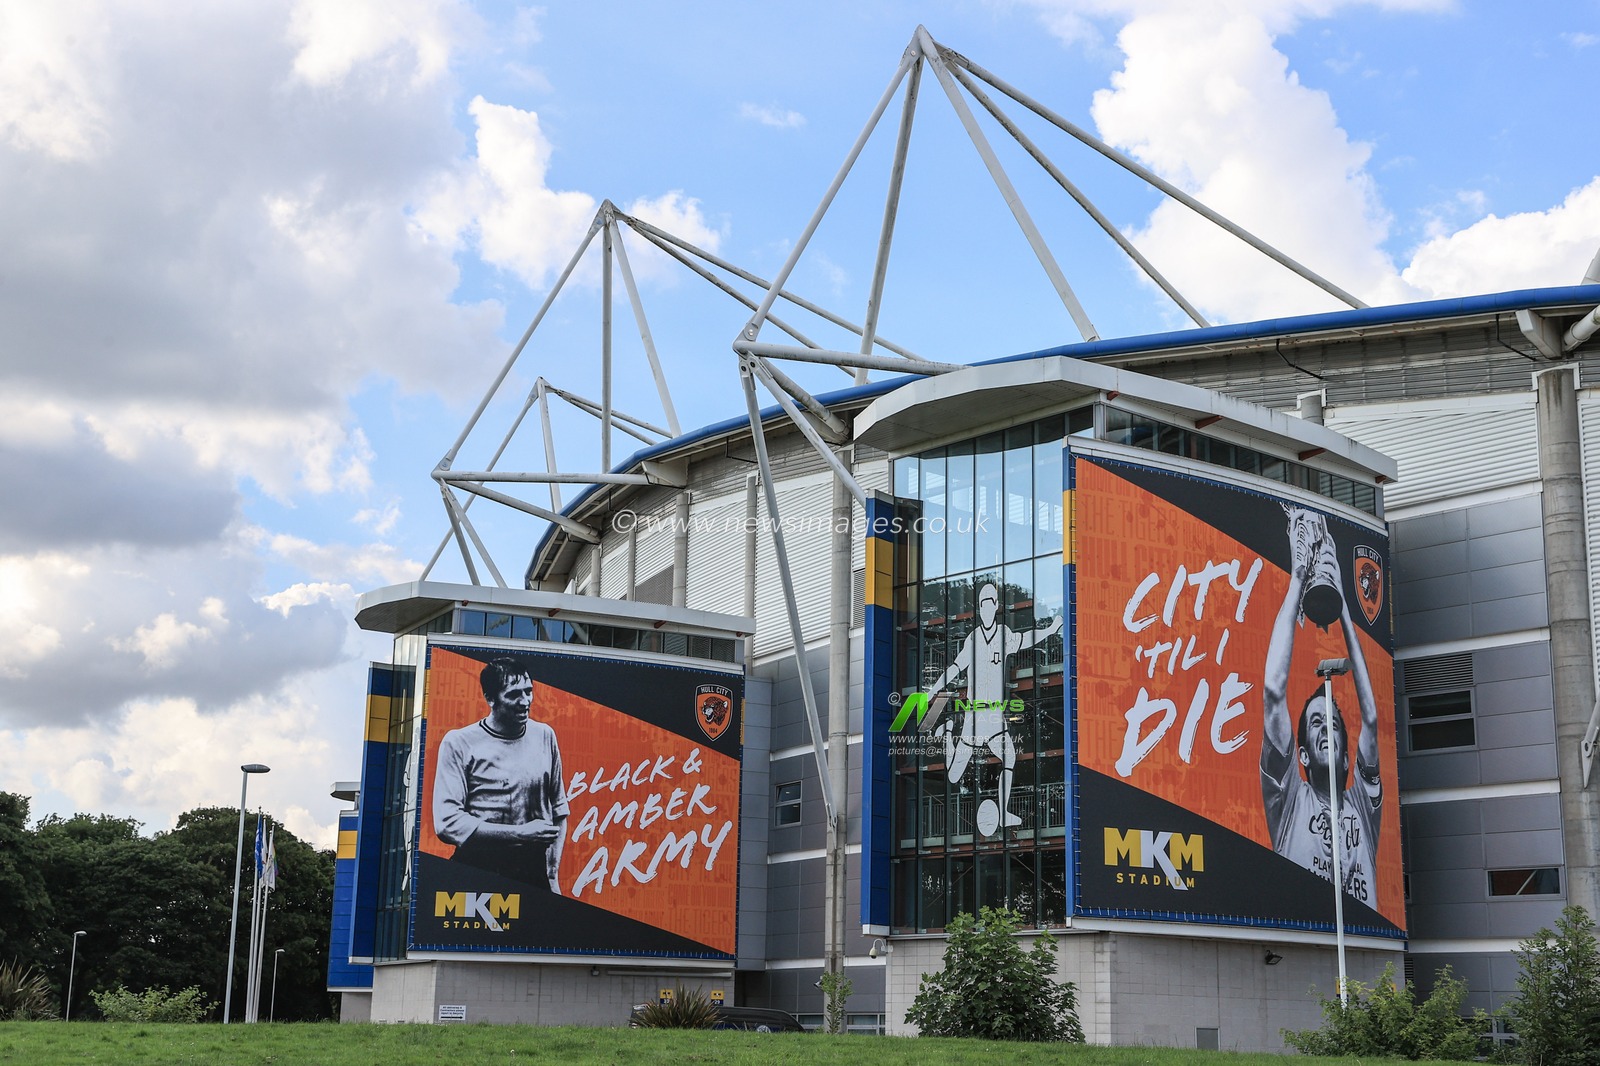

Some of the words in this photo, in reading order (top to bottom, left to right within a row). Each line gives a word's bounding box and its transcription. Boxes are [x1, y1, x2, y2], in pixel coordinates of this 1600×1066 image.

[1122, 557, 1263, 634] CITY
[1215, 628, 1229, 666] I
[716, 687, 729, 696] CITY
[1114, 673, 1254, 778] DIE
[566, 754, 675, 803] BLACK
[683, 747, 702, 774] &
[571, 785, 718, 843] AMBER
[571, 820, 733, 898] ARMY
[1104, 826, 1204, 892] MKM
[1116, 872, 1196, 889] STADIUM
[434, 891, 521, 932] MKM
[443, 920, 510, 931] STADIUM
